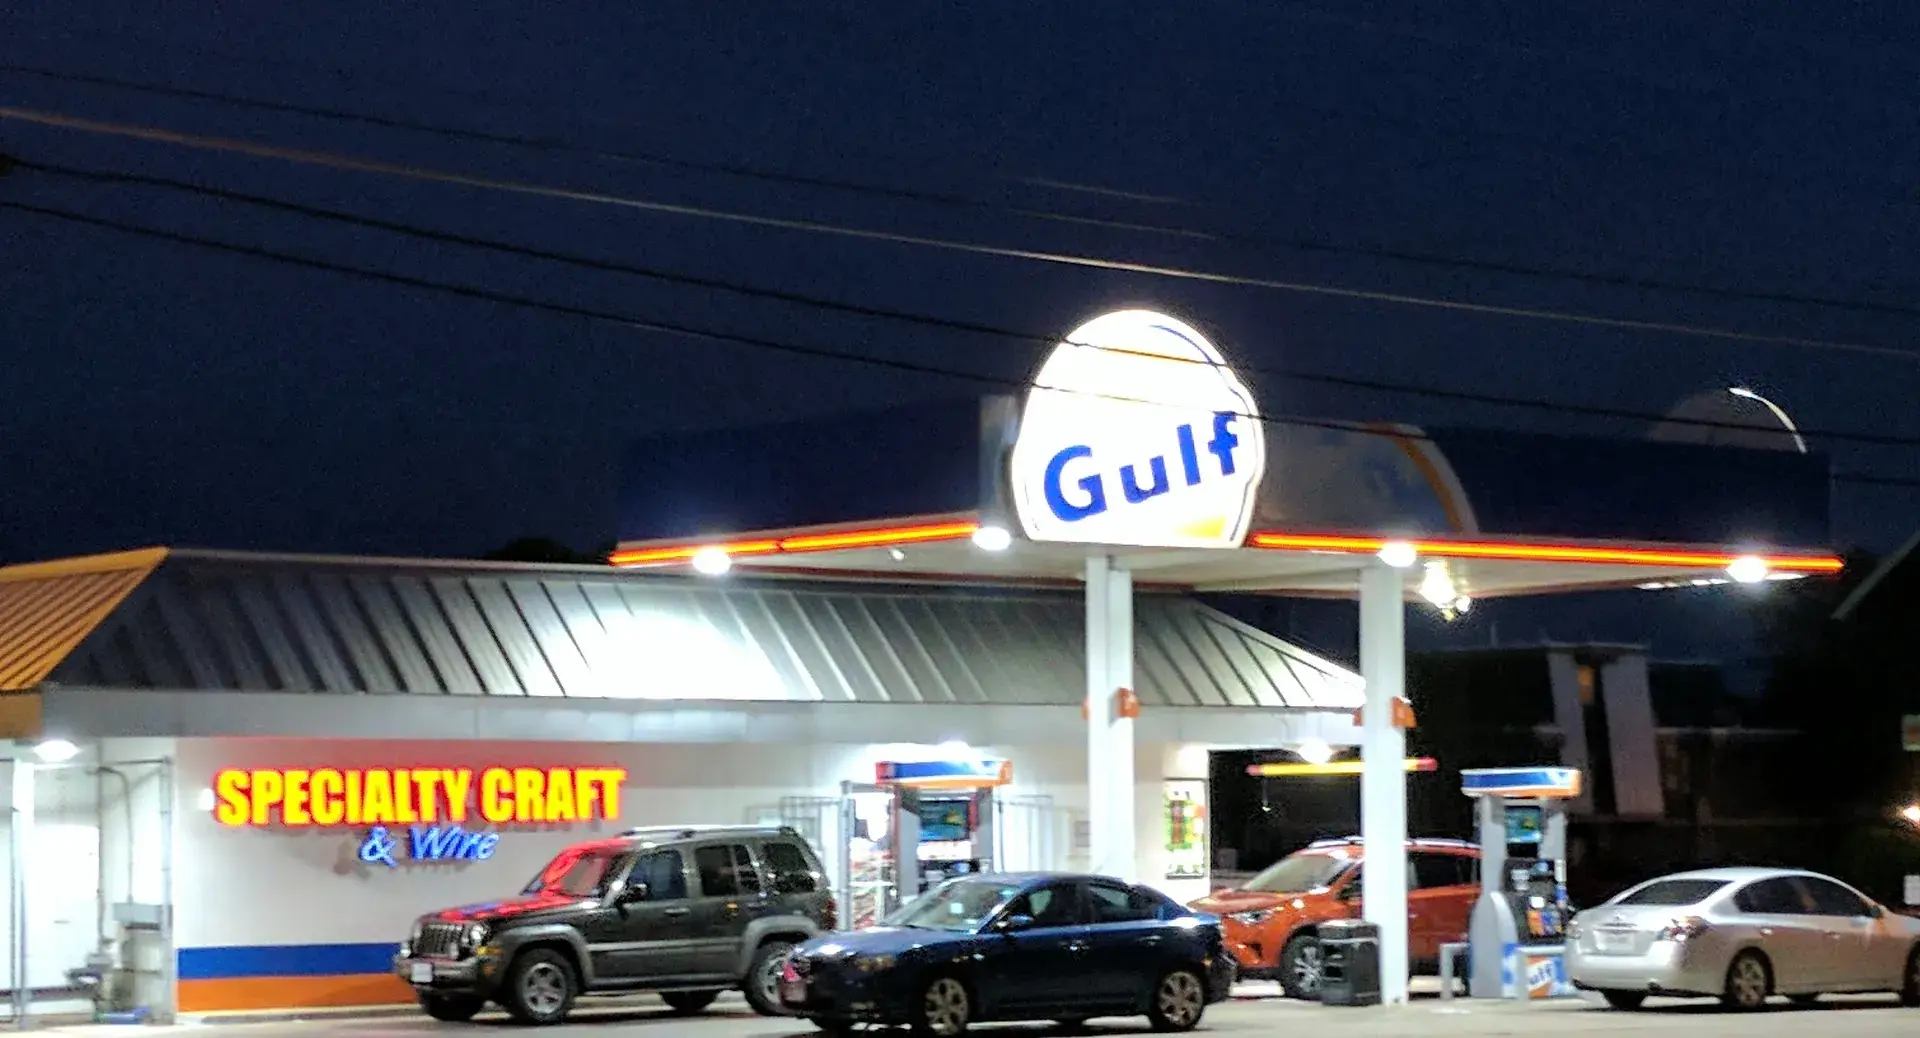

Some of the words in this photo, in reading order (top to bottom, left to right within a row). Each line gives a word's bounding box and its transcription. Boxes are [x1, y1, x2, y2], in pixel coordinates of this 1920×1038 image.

[1043, 411, 1240, 523] Gulf
[214, 767, 474, 828] SPECIALTY
[480, 766, 628, 824] CRAFT
[358, 827, 397, 868] &
[409, 824, 500, 862] Wire
